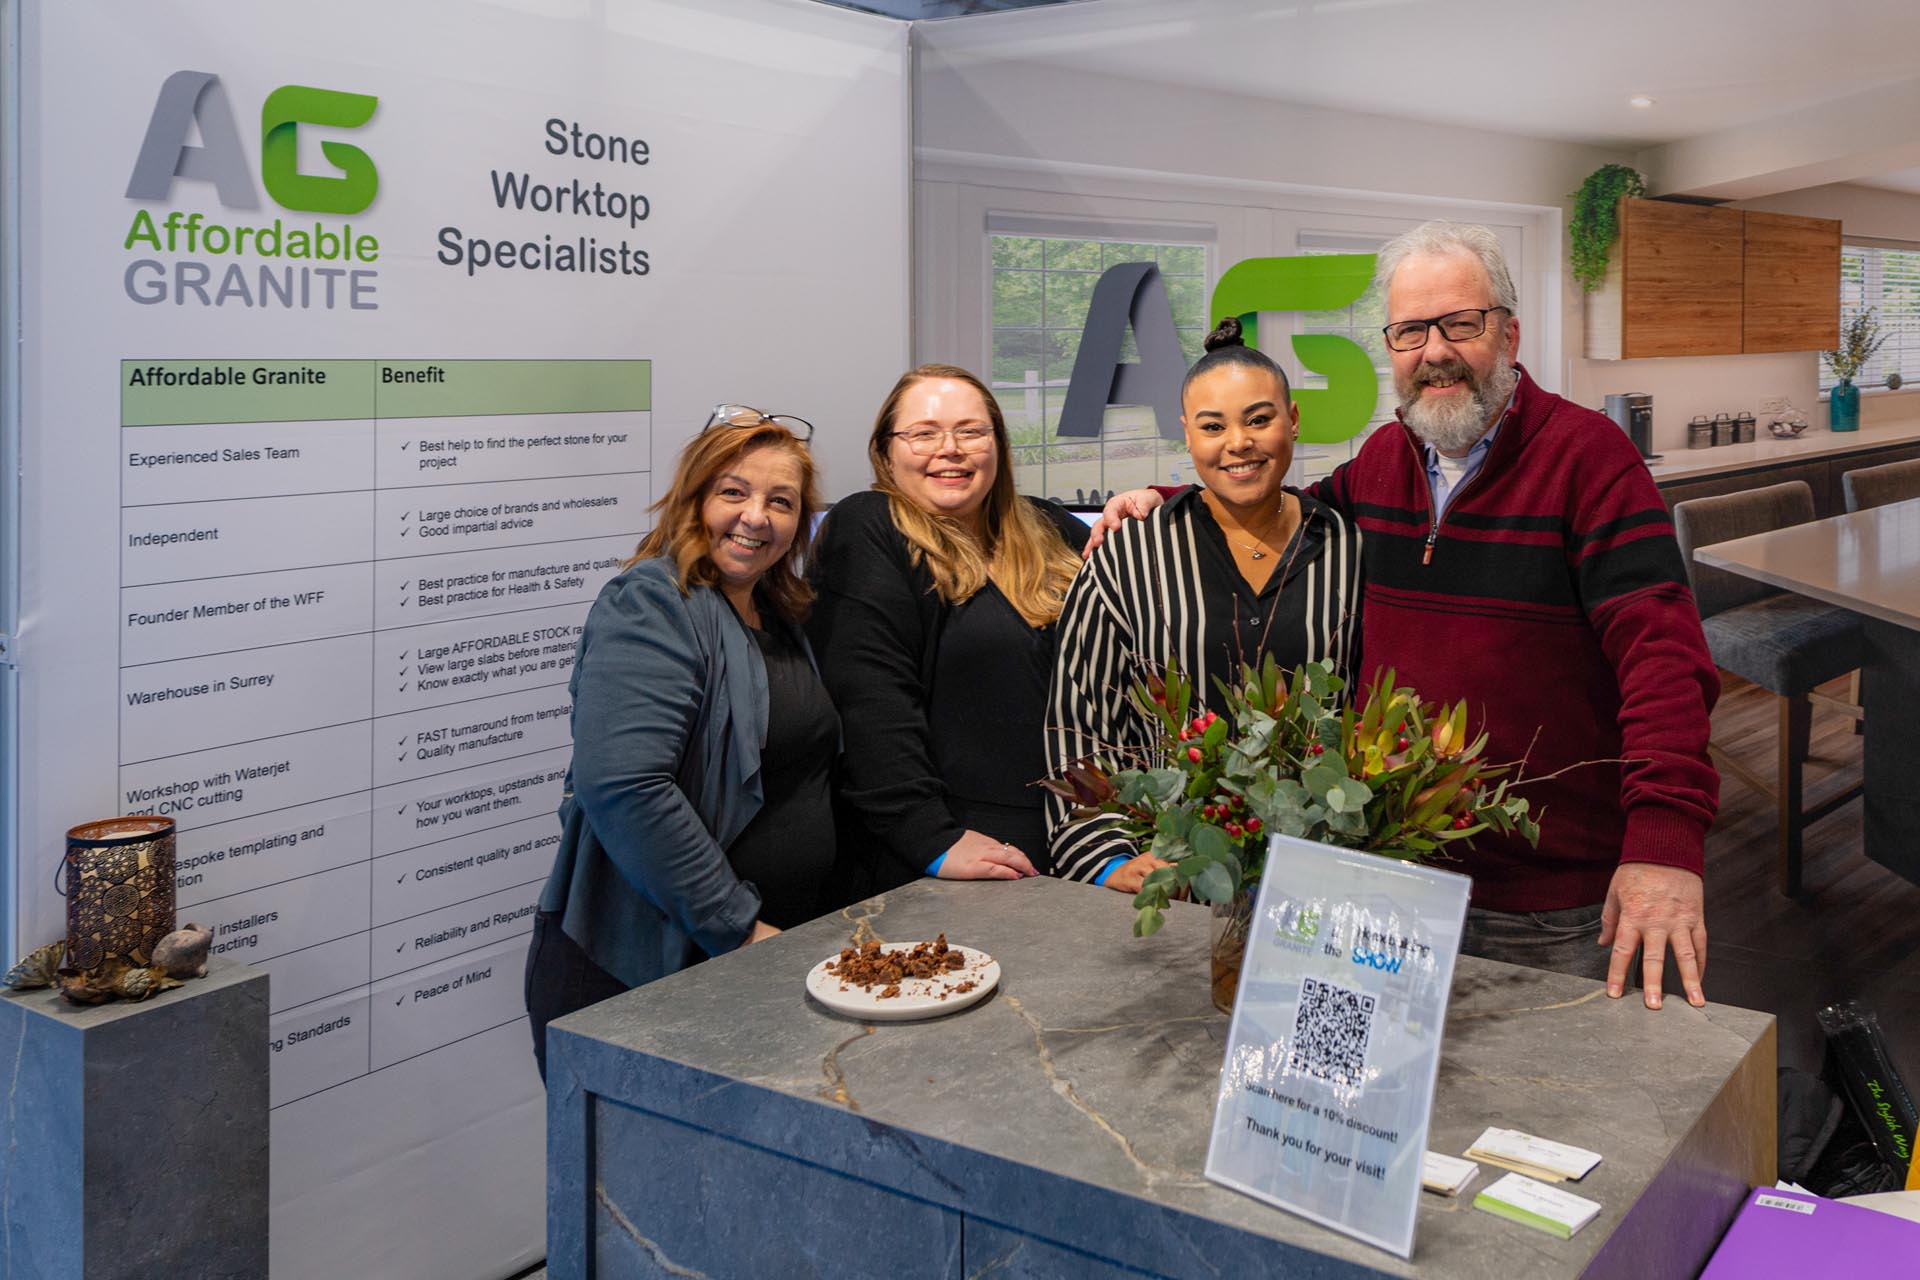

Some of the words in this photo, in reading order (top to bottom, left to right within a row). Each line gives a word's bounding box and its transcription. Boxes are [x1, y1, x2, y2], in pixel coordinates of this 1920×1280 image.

[124, 69, 378, 215] AG
[544, 118, 650, 166] Stone
[491, 170, 650, 229] Worktop
[124, 209, 379, 262] Affordable
[437, 226, 650, 276] Specialists
[124, 259, 379, 310] GRANITE
[129, 367, 246, 386] Affordable
[252, 367, 326, 385] Granite
[382, 366, 445, 384] Benefit
[129, 450, 218, 469] Experienced
[222, 448, 260, 462] Sales
[265, 447, 300, 460] Team
[420, 440, 445, 452] Best
[448, 440, 471, 453] help
[473, 439, 484, 450] to
[487, 437, 506, 449] find
[508, 437, 525, 448] the
[527, 435, 561, 449] perfect
[564, 434, 590, 445] stone
[592, 433, 605, 443] for
[608, 433, 628, 446] your
[420, 456, 457, 471] project
[419, 510, 450, 524] Large
[454, 506, 488, 519] choice
[491, 504, 502, 516] of
[504, 501, 539, 514] brands
[542, 499, 560, 511] and
[562, 495, 618, 510] wholesalers
[129, 528, 219, 547] Independent
[419, 526, 449, 538] Good
[452, 520, 498, 536] impartial
[500, 518, 533, 530] advice
[418, 578, 443, 591] Best
[446, 573, 489, 589] practice
[491, 571, 505, 582] for
[508, 564, 570, 581] manufacture
[572, 560, 591, 573] and
[418, 593, 443, 607] Best
[446, 588, 489, 605] practice
[491, 586, 505, 598] for
[508, 582, 540, 596] Health
[543, 581, 552, 590] &
[554, 576, 585, 591] Safety
[128, 608, 189, 626] Founder
[193, 602, 250, 619] Member
[253, 598, 267, 610] of
[270, 595, 290, 609] the
[294, 591, 325, 606] WFF
[418, 645, 449, 660] Large
[452, 632, 530, 654] AFFORDABLE
[532, 625, 571, 642] STOCK
[418, 664, 449, 676] View
[448, 659, 475, 673] large
[478, 653, 505, 666] slabs
[508, 648, 540, 661] before
[543, 641, 577, 655] materia
[127, 683, 209, 706] Warehouse
[213, 680, 225, 692] in
[230, 673, 274, 690] Surrey
[418, 678, 449, 692] Know
[452, 670, 489, 686] exactly
[492, 665, 517, 678] what
[519, 662, 538, 676] you
[540, 659, 556, 670] are
[559, 656, 575, 669] get
[417, 728, 448, 745] FAST
[451, 718, 508, 738] turnaround
[511, 712, 534, 726] from
[536, 704, 572, 721] templat
[417, 744, 455, 761] Quality
[459, 729, 523, 752] manufacture
[127, 779, 199, 804] Workshop
[203, 772, 231, 788] with
[235, 760, 290, 782] Waterjet
[416, 798, 442, 814] Your
[445, 786, 495, 807] worktops,
[498, 771, 545, 793] upstands
[547, 768, 566, 781] and
[159, 797, 193, 815] CNC
[197, 788, 243, 807] cutting
[416, 814, 439, 829] how
[442, 811, 462, 825] you
[465, 803, 490, 817] want
[493, 795, 522, 808] them.
[176, 850, 225, 871] espoke
[229, 832, 297, 858] templating
[301, 825, 324, 841] and
[416, 856, 474, 881] Consistent
[476, 847, 510, 866] quality
[513, 840, 532, 855] and
[219, 911, 278, 936] installers
[415, 925, 468, 950] Reliability
[470, 916, 490, 933] and
[493, 903, 540, 926] Reputati
[1352, 947, 1403, 973] SHOW
[414, 984, 449, 1003] Peace
[452, 976, 464, 988] of
[466, 967, 492, 985] Mind
[287, 1015, 351, 1046] Standards
[1245, 1080, 1271, 1097] Scan
[1271, 1090, 1295, 1106] here
[1297, 1097, 1311, 1112] for
[1313, 1105, 1320, 1116] a
[1323, 1108, 1345, 1126] 10%
[1346, 1117, 1399, 1144] discount!
[1246, 1116, 1280, 1141] Thank
[1281, 1133, 1303, 1150] you
[1305, 1140, 1321, 1156] for
[1324, 1150, 1351, 1168] your
[1355, 1160, 1386, 1181] visit!
